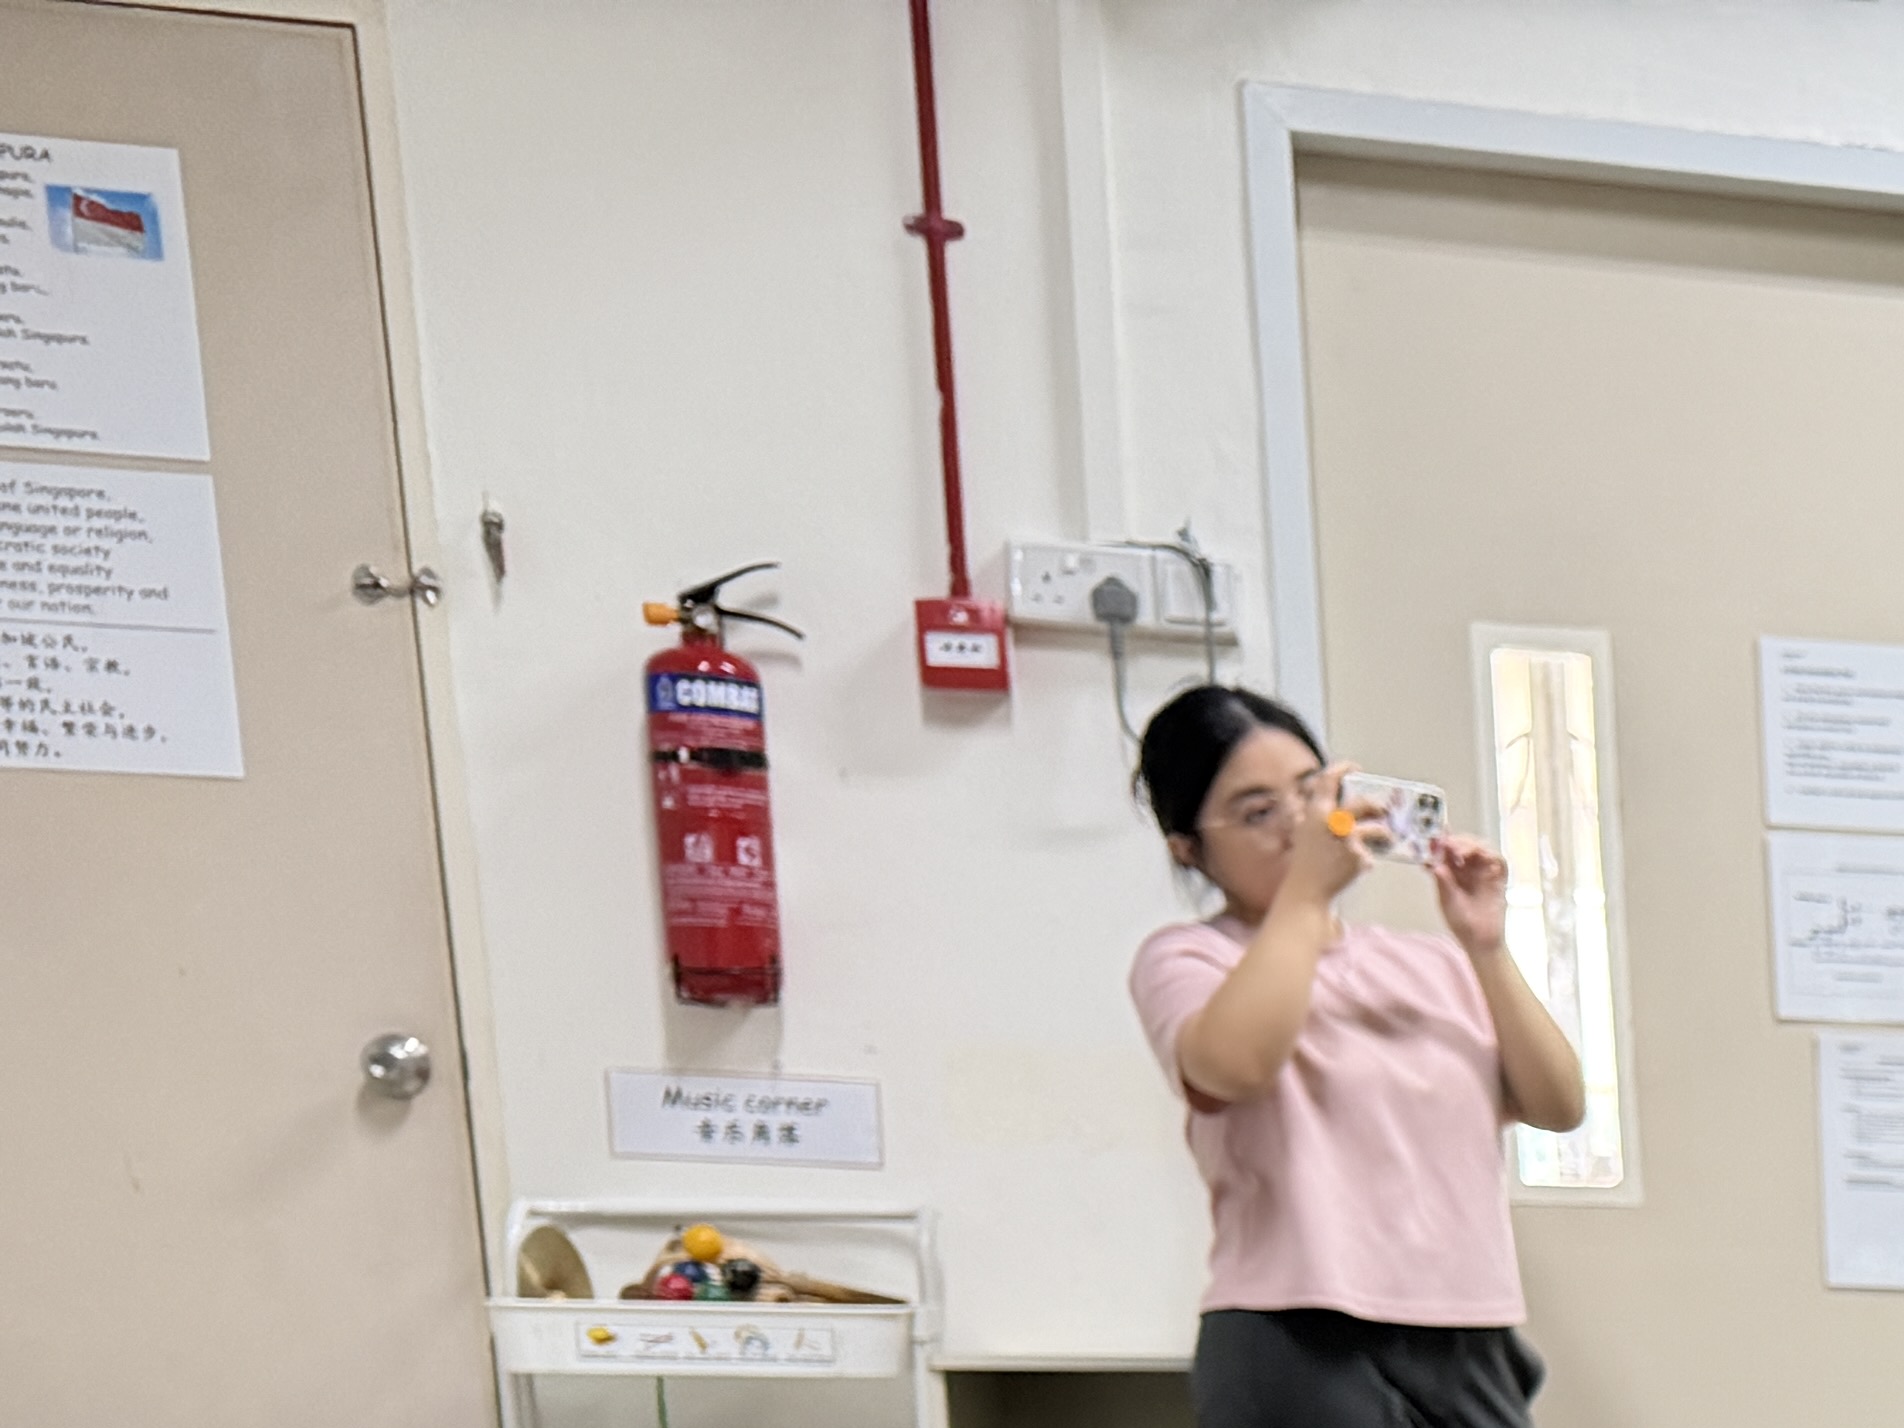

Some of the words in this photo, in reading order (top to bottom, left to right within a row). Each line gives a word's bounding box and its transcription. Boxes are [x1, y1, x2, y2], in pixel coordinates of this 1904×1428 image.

[27, 503, 80, 517] united
[63, 525, 82, 537] or
[51, 544, 111, 561] society
[12, 561, 42, 573] and
[48, 563, 113, 580] equality
[48, 582, 134, 602] prosperity
[139, 587, 169, 600] and
[8, 599, 34, 611] our
[661, 1084, 736, 1114] Music
[743, 1094, 829, 1116] corner
